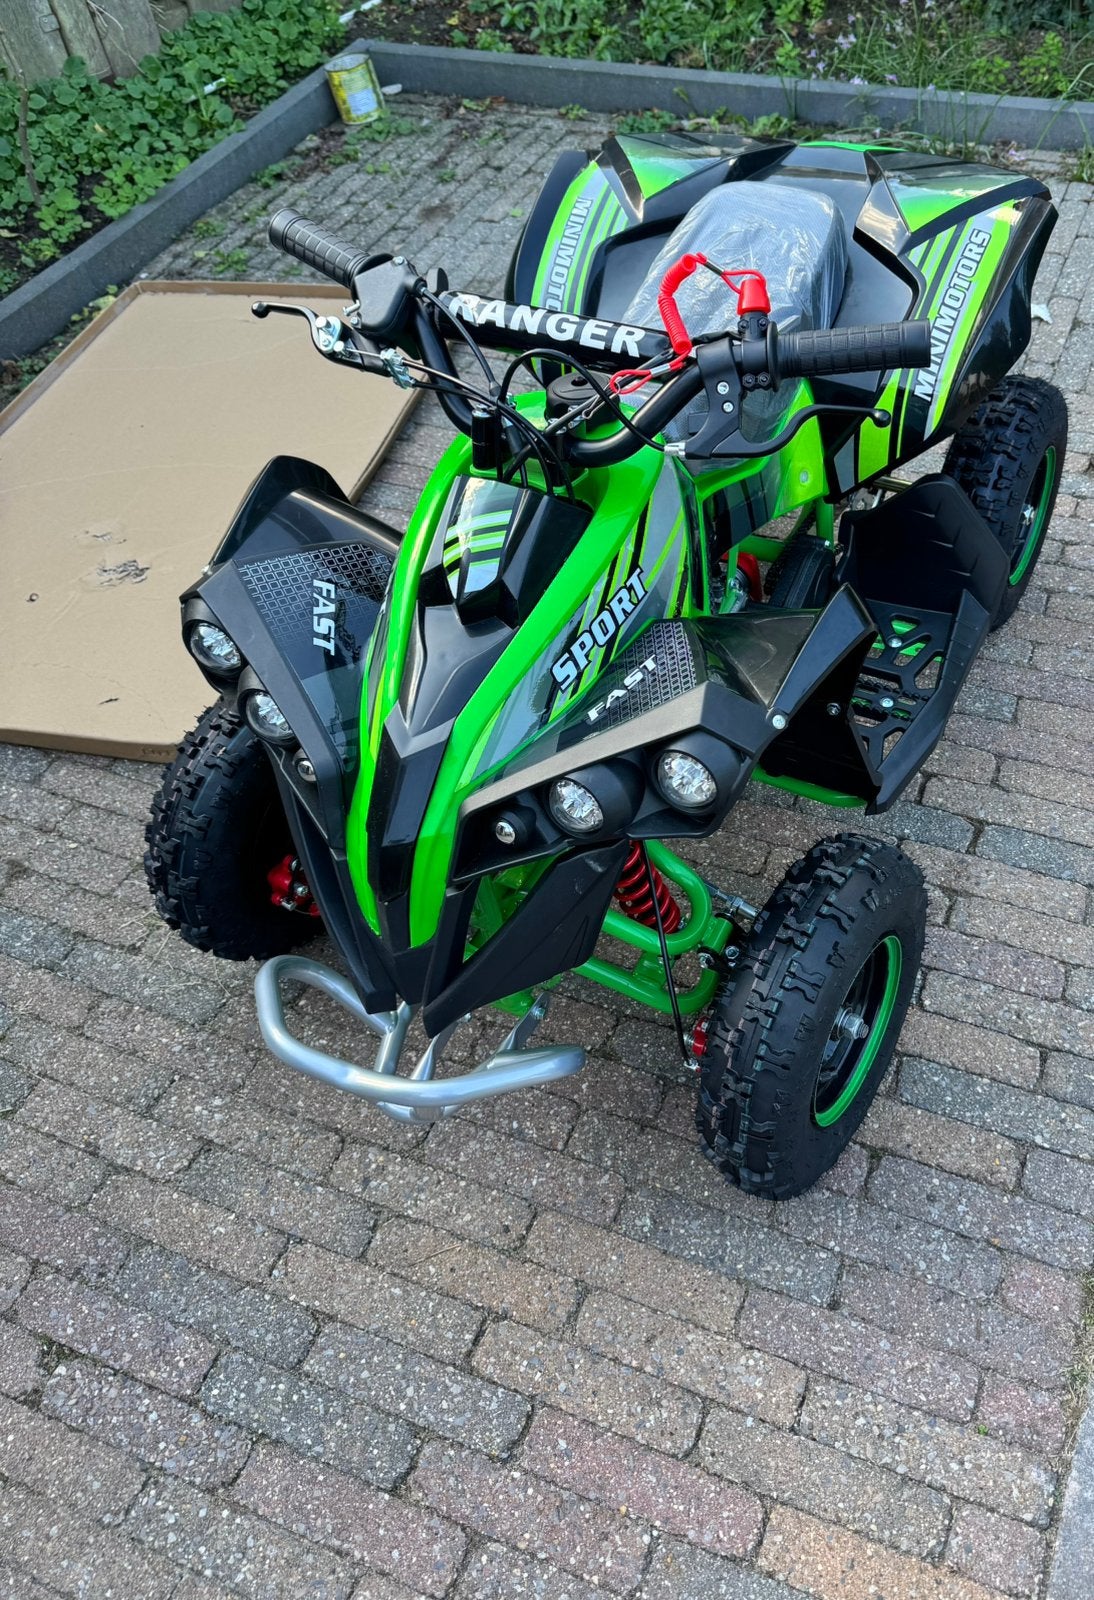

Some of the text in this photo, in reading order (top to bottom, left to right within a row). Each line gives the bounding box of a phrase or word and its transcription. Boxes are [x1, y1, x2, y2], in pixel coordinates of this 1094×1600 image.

[449, 293, 646, 358] RANGER
[312, 579, 336, 657] FAST
[550, 566, 648, 692] SPORT
[587, 654, 657, 722] FAST
